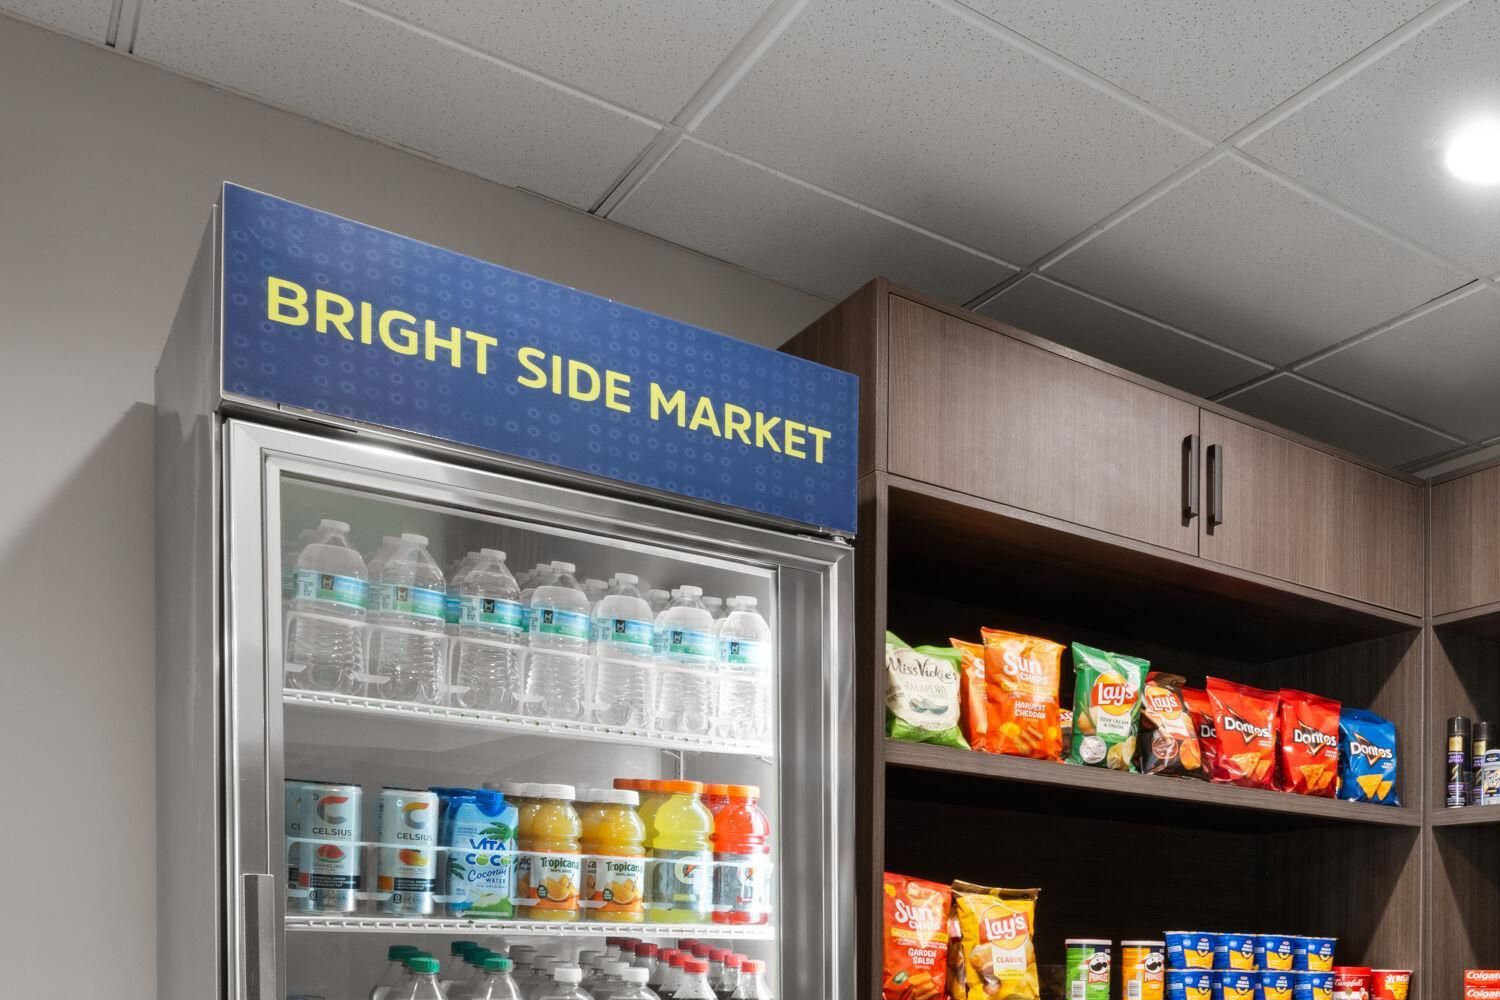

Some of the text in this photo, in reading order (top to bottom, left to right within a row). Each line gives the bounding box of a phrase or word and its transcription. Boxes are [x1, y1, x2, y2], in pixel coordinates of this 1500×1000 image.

[266, 276, 831, 463] BRIGHT SIDE MARKET
[1003, 651, 1043, 676] Sun
[1098, 682, 1135, 706] Lay's
[1015, 700, 1046, 711] HARVEST
[1148, 693, 1179, 713] Lay's
[1014, 709, 1046, 720] CHEDDAR
[1224, 716, 1273, 738] Doritos
[1294, 729, 1337, 747] Doritos
[1350, 742, 1392, 759] Doritos
[312, 827, 352, 836] CELSIUS
[397, 832, 433, 841] CELSIUS
[469, 838, 506, 851] VITA
[465, 853, 512, 867] COCO
[895, 898, 934, 923] Sun
[984, 912, 1027, 940] Lay's
[908, 948, 937, 957] GARDEN
[913, 956, 935, 966] SALSA
